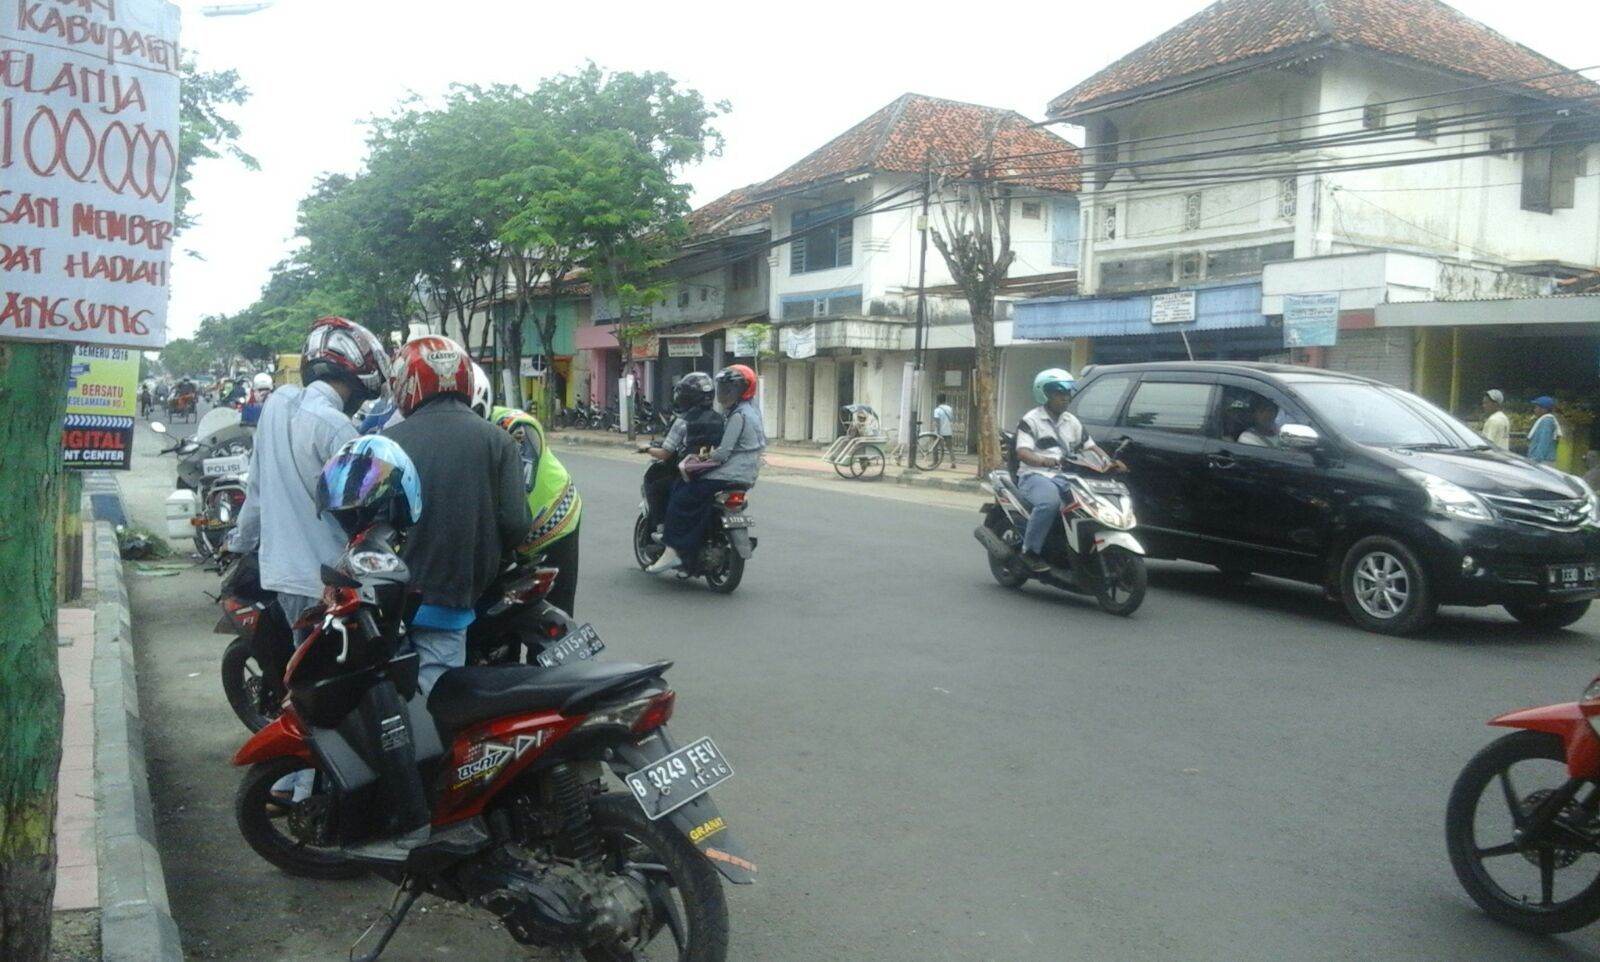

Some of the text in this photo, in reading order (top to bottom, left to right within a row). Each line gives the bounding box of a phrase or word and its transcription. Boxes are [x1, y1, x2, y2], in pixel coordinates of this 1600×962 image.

[73, 203, 174, 250] MEMBER
[64, 251, 165, 287] HADIAH
[82, 384, 124, 398] BERSATU
[82, 450, 124, 460] CENTER
[206, 464, 241, 474] POLISI
[631, 741, 717, 798] B 3249 FEV
